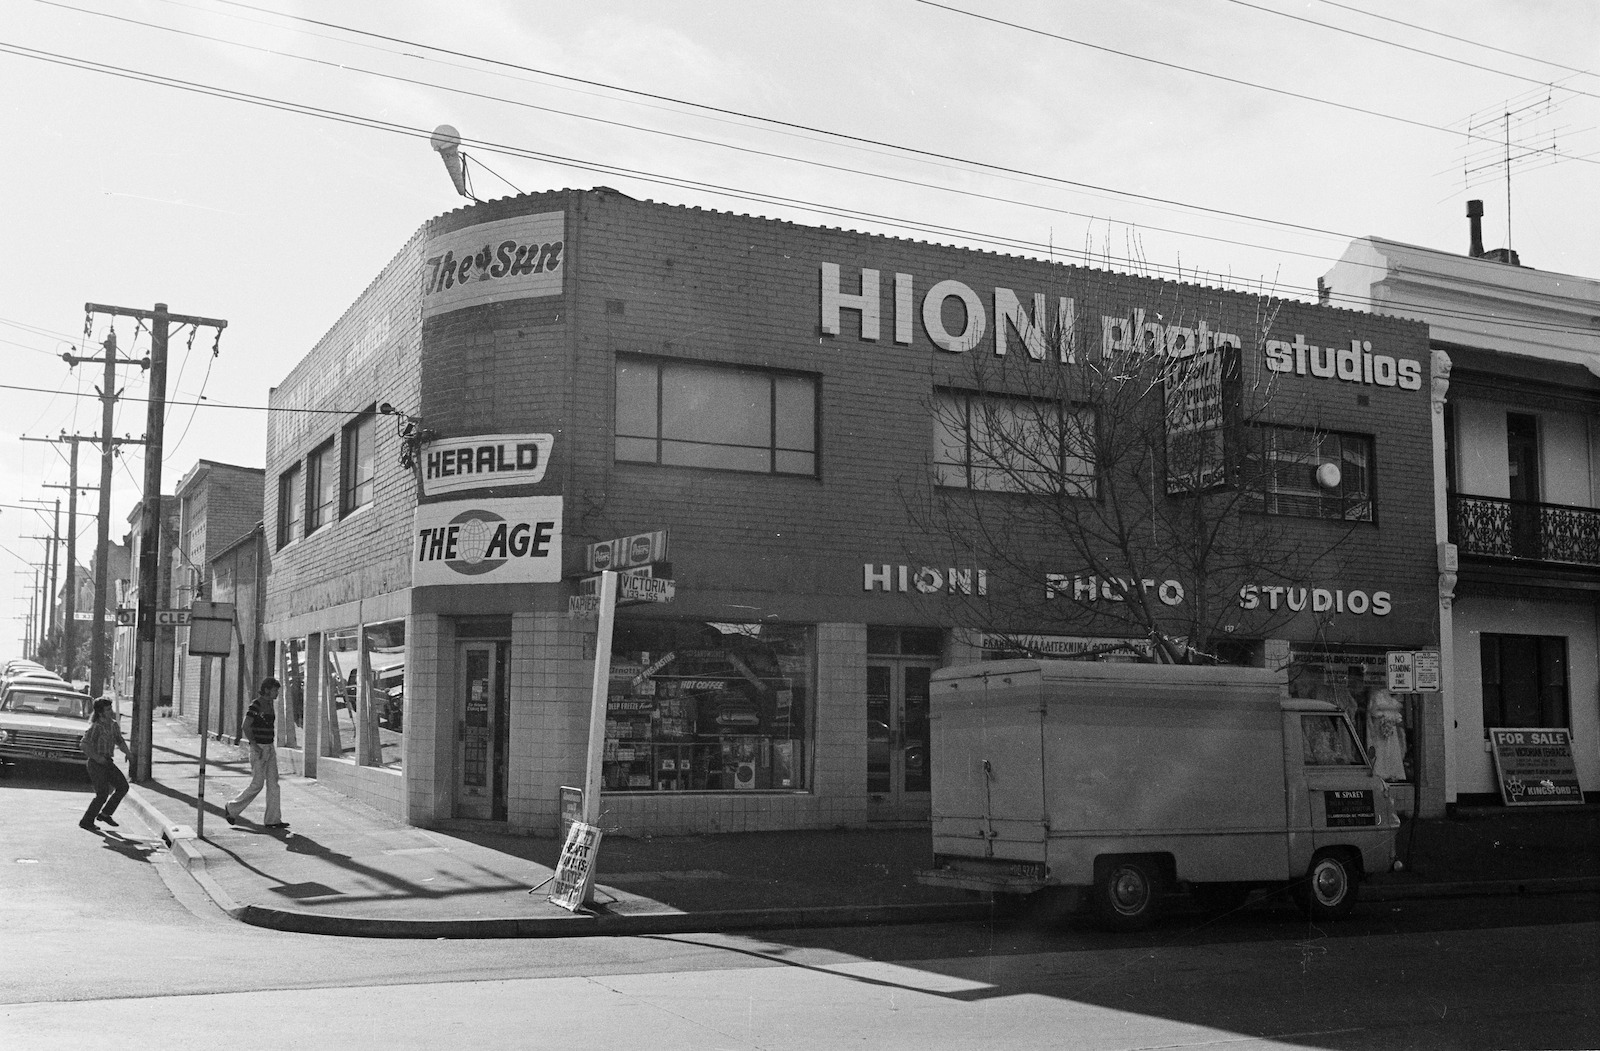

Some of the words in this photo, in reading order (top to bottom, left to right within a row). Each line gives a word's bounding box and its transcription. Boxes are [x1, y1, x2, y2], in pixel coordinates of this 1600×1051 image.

[426, 250, 472, 296] The
[490, 240, 564, 279] Sun
[820, 261, 1077, 364] HIONI
[1265, 333, 1422, 391] studios
[427, 443, 538, 479] HERALD
[419, 526, 460, 562] THE
[485, 521, 554, 558] AGE
[632, 543, 650, 556] Peters
[623, 576, 666, 594] VICTORIA
[864, 563, 987, 596] HIONI
[1045, 573, 1185, 606] PHOTO
[1239, 584, 1392, 616] STUDIOS
[570, 597, 597, 611] NAPIER
[159, 612, 193, 623] CLEA
[1394, 655, 1405, 664] NO
[1389, 664, 1412, 672] STANDING
[681, 681, 697, 690] HOT
[696, 681, 725, 690] COFFEE
[621, 702, 638, 711] FREEZE
[1497, 733, 1525, 745] FOR
[1531, 733, 1566, 745] SALE
[1527, 785, 1572, 796] KINGSFORD
